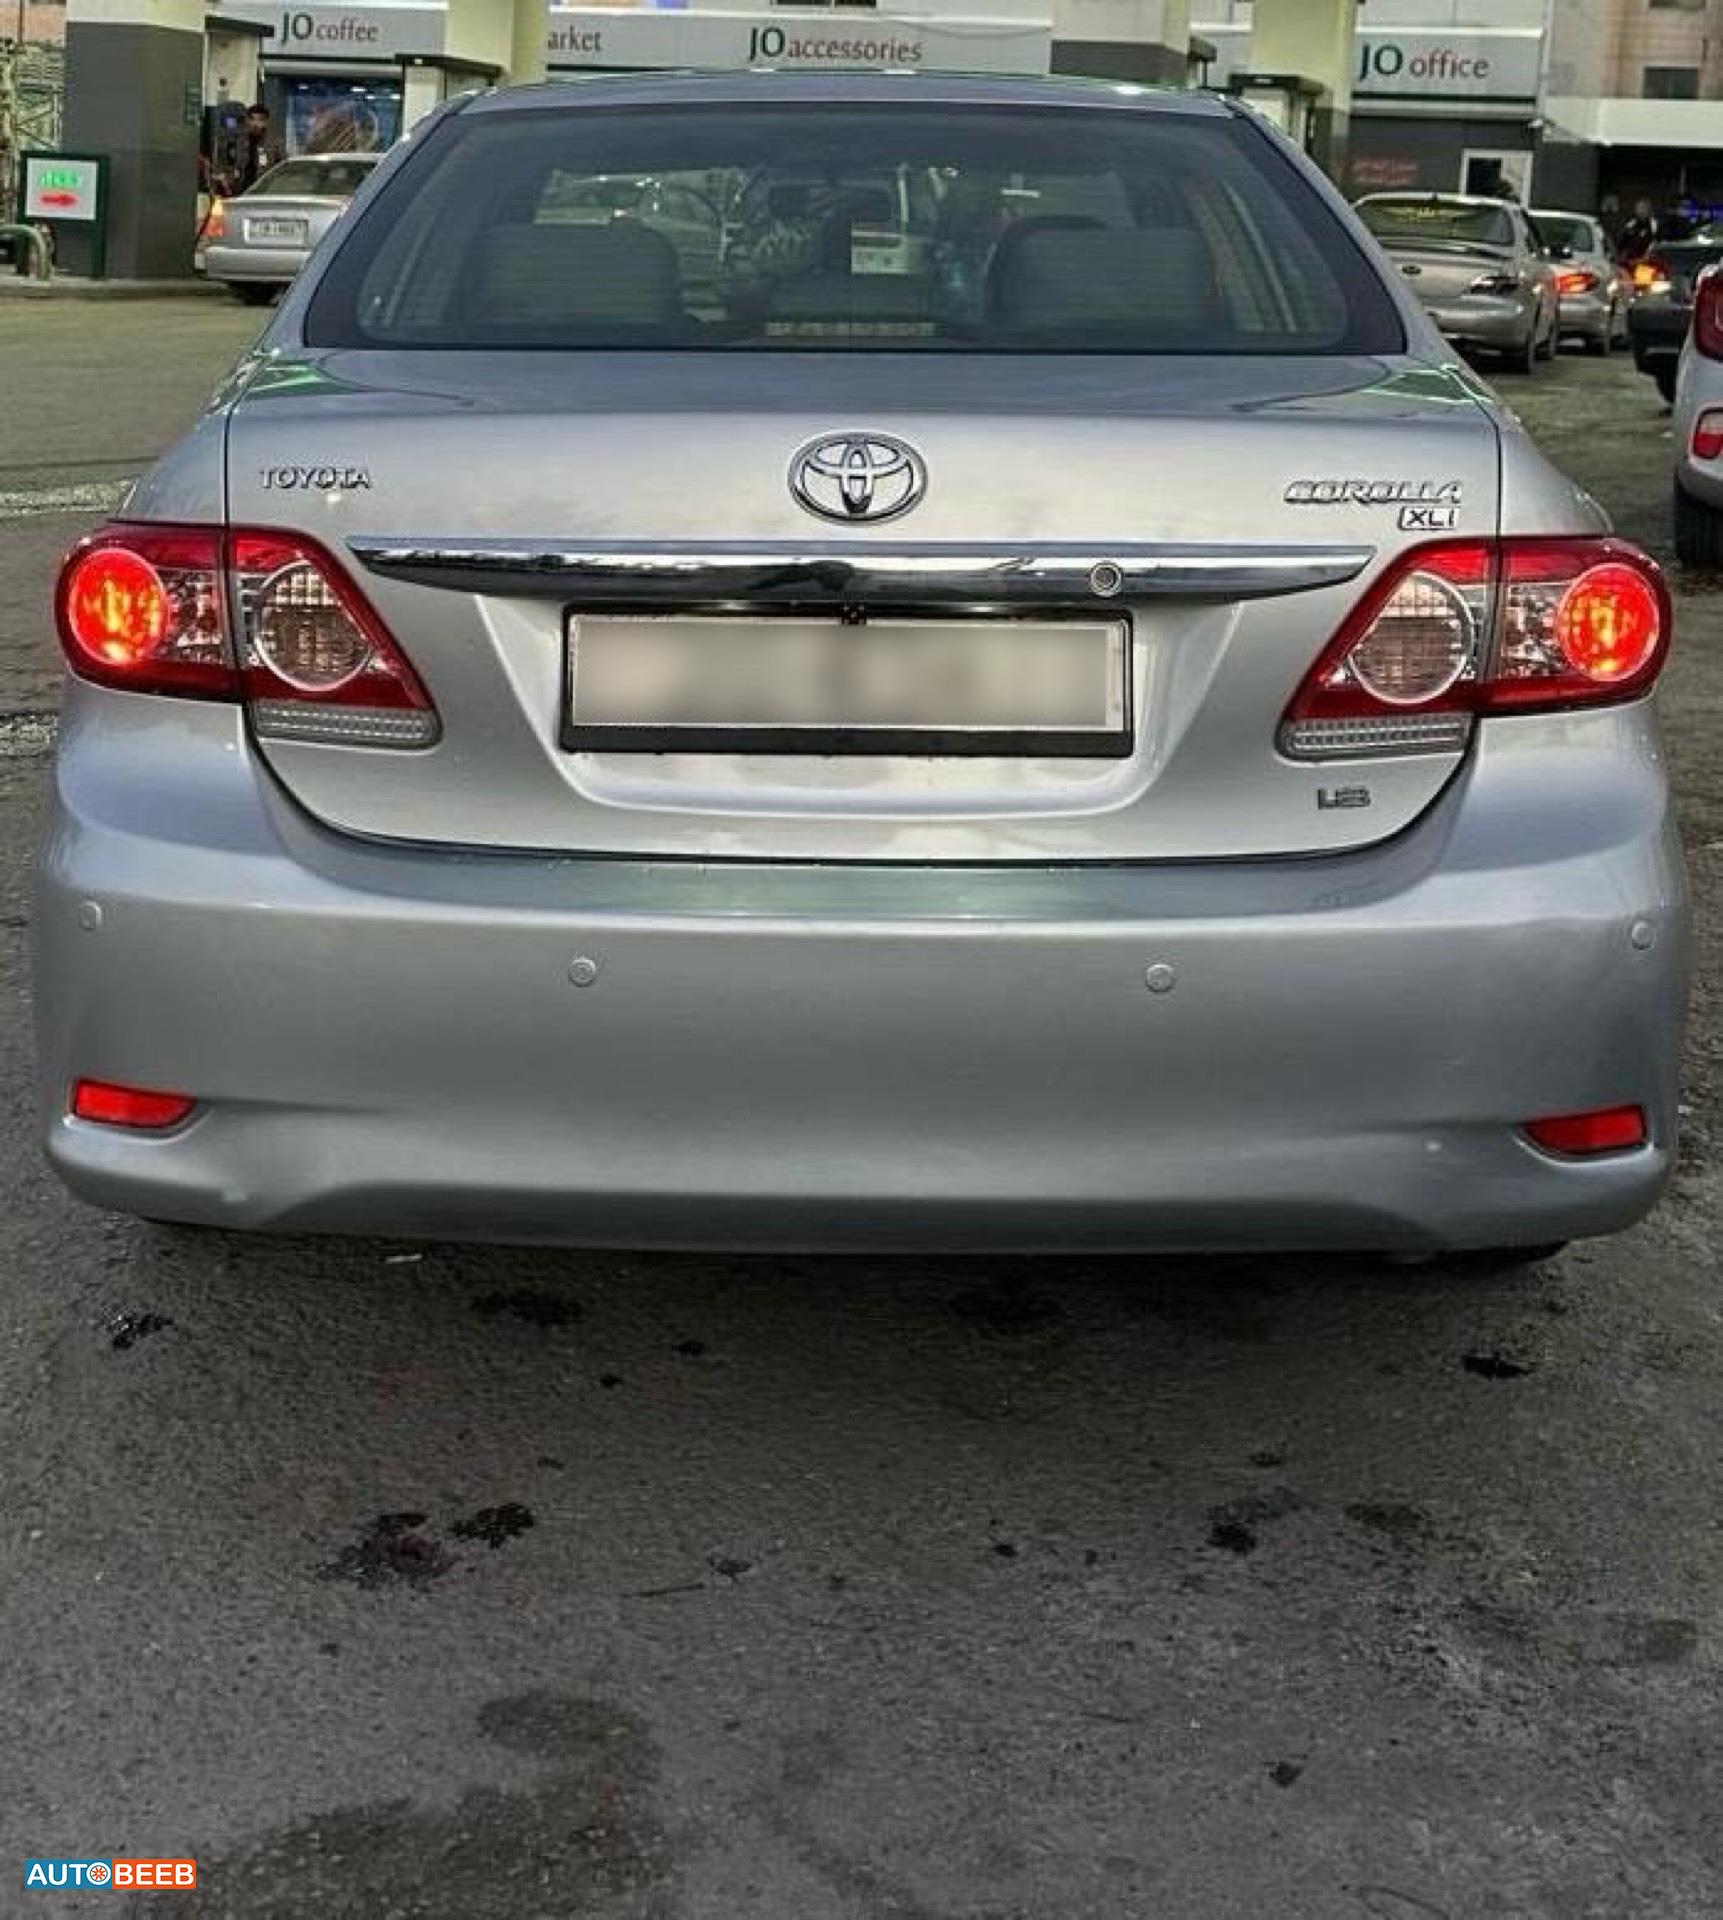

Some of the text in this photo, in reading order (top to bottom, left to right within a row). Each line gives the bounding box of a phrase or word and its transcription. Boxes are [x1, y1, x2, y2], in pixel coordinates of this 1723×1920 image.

[281, 11, 379, 47] JO coffee
[547, 24, 602, 53] arket
[749, 26, 924, 63] JO accessories
[1358, 44, 1490, 82] JO office
[259, 466, 370, 489] TOYOTA
[1284, 480, 1462, 506] COROLLA
